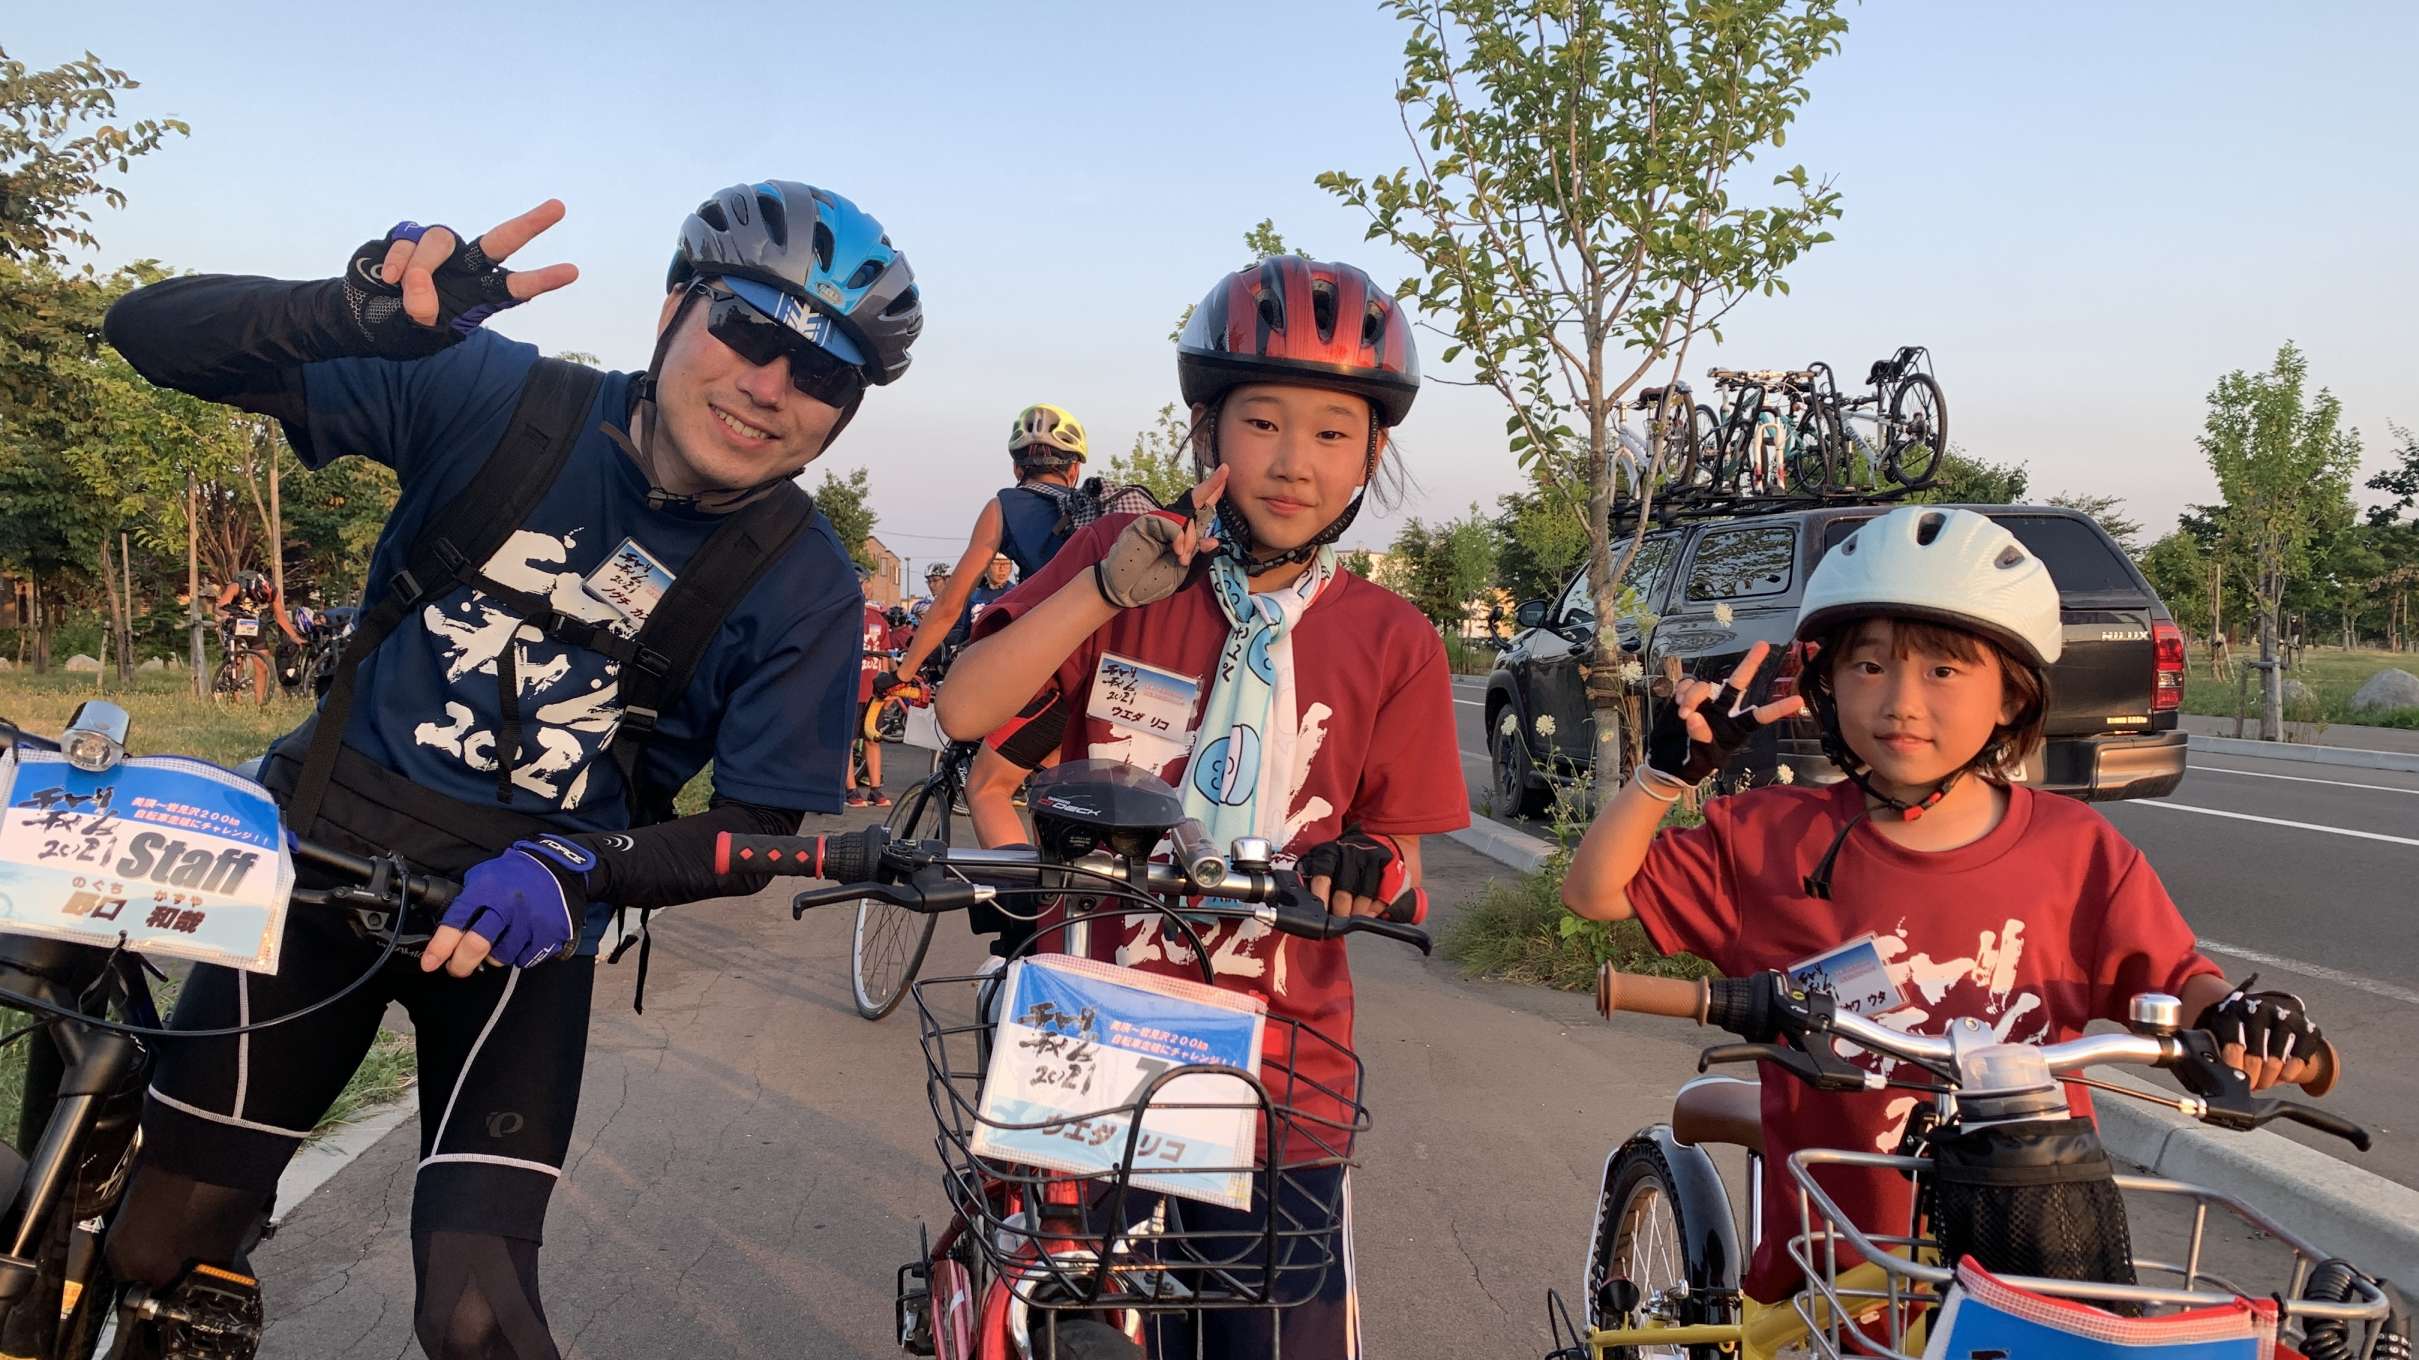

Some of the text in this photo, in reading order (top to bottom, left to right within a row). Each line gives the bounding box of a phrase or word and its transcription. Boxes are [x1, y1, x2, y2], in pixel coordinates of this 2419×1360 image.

[601, 588, 632, 605] ノグチ
[2102, 631, 2149, 641] HILUX
[1106, 691, 1137, 705] 2021
[1111, 706, 1170, 731] ウエダ リコ
[38, 836, 118, 867] 2021
[116, 830, 261, 897] Staff
[1838, 990, 1887, 1013] カワ ウタ
[1030, 1063, 1097, 1096] 2021
[1042, 1113, 1187, 1163] ウエダ リコ
